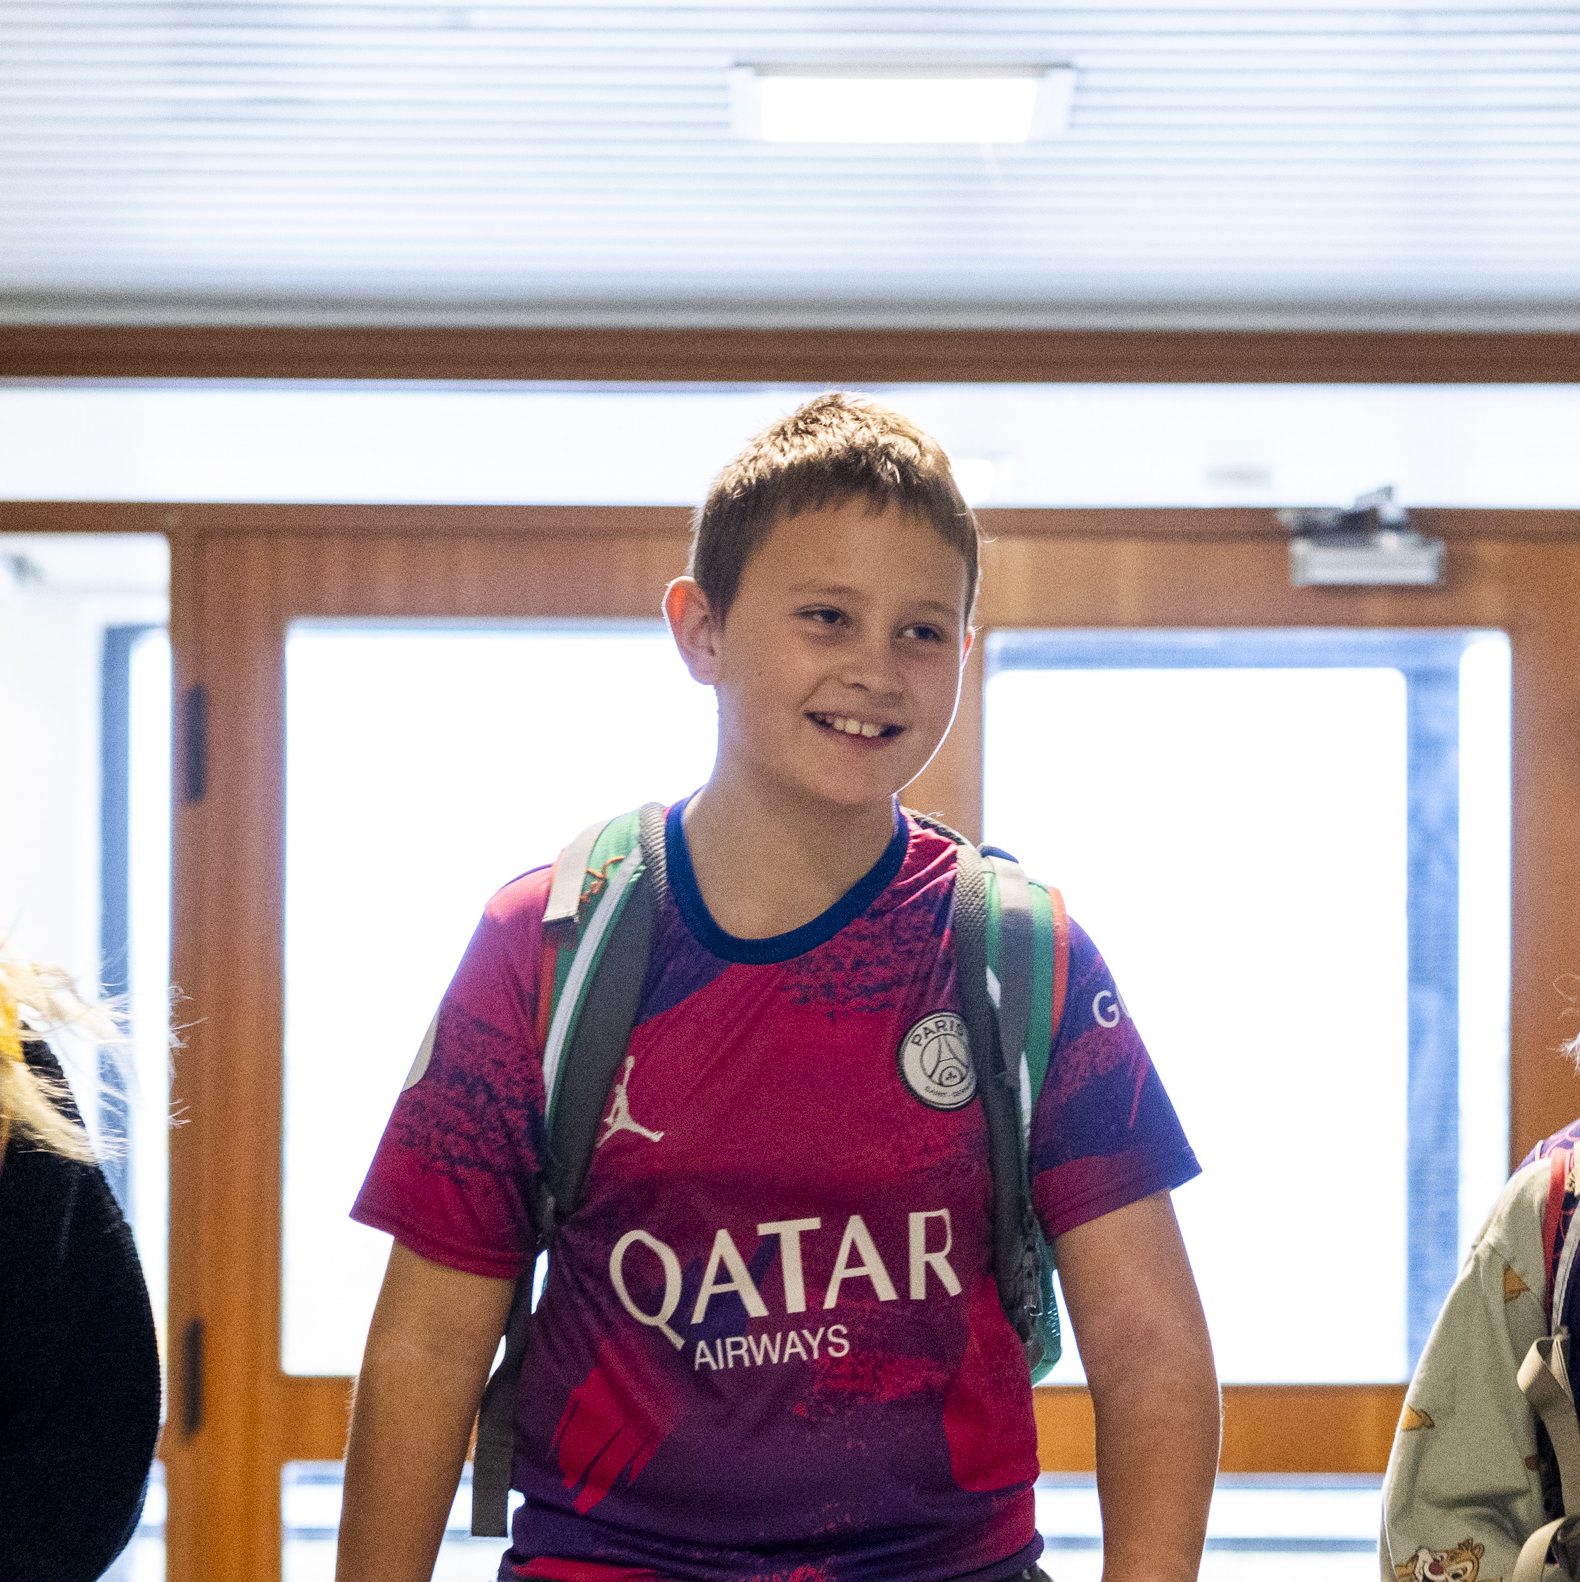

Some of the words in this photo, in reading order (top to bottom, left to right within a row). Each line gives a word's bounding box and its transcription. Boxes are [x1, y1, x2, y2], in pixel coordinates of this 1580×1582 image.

[910, 1019, 965, 1047] PARIS
[608, 1207, 963, 1351] QATAR
[694, 1324, 851, 1371] AIRWAYS
